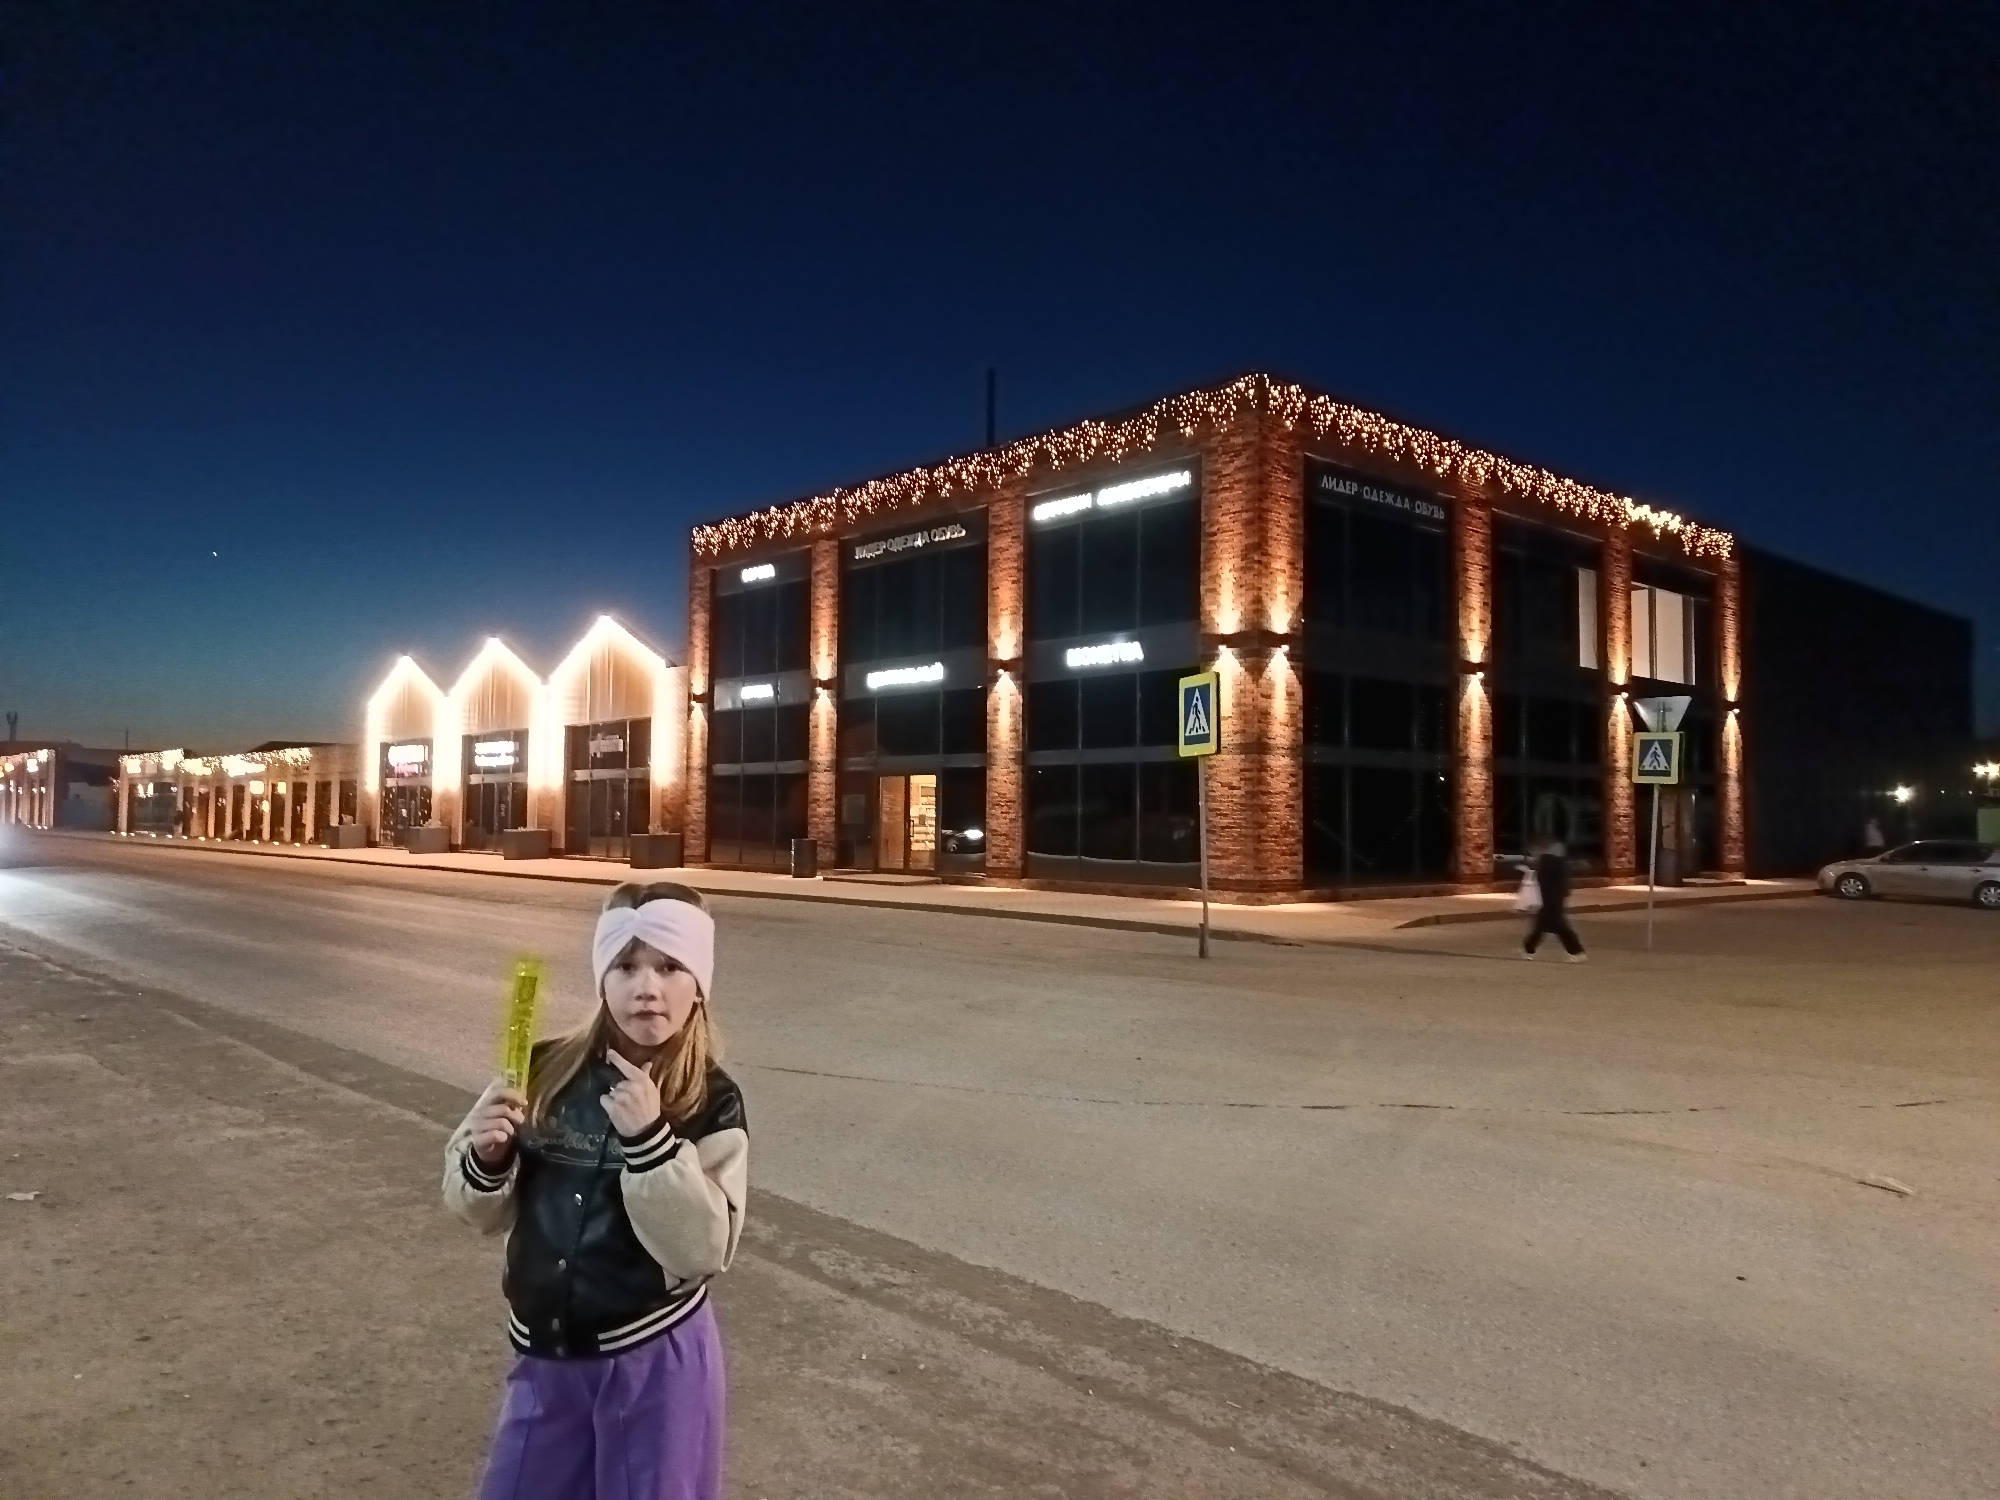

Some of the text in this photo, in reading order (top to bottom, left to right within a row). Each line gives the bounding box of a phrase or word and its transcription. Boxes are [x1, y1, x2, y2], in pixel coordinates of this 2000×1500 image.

[1321, 475, 1445, 519] ЛИДЕР ОДЕЖДА ОБУВЬ
